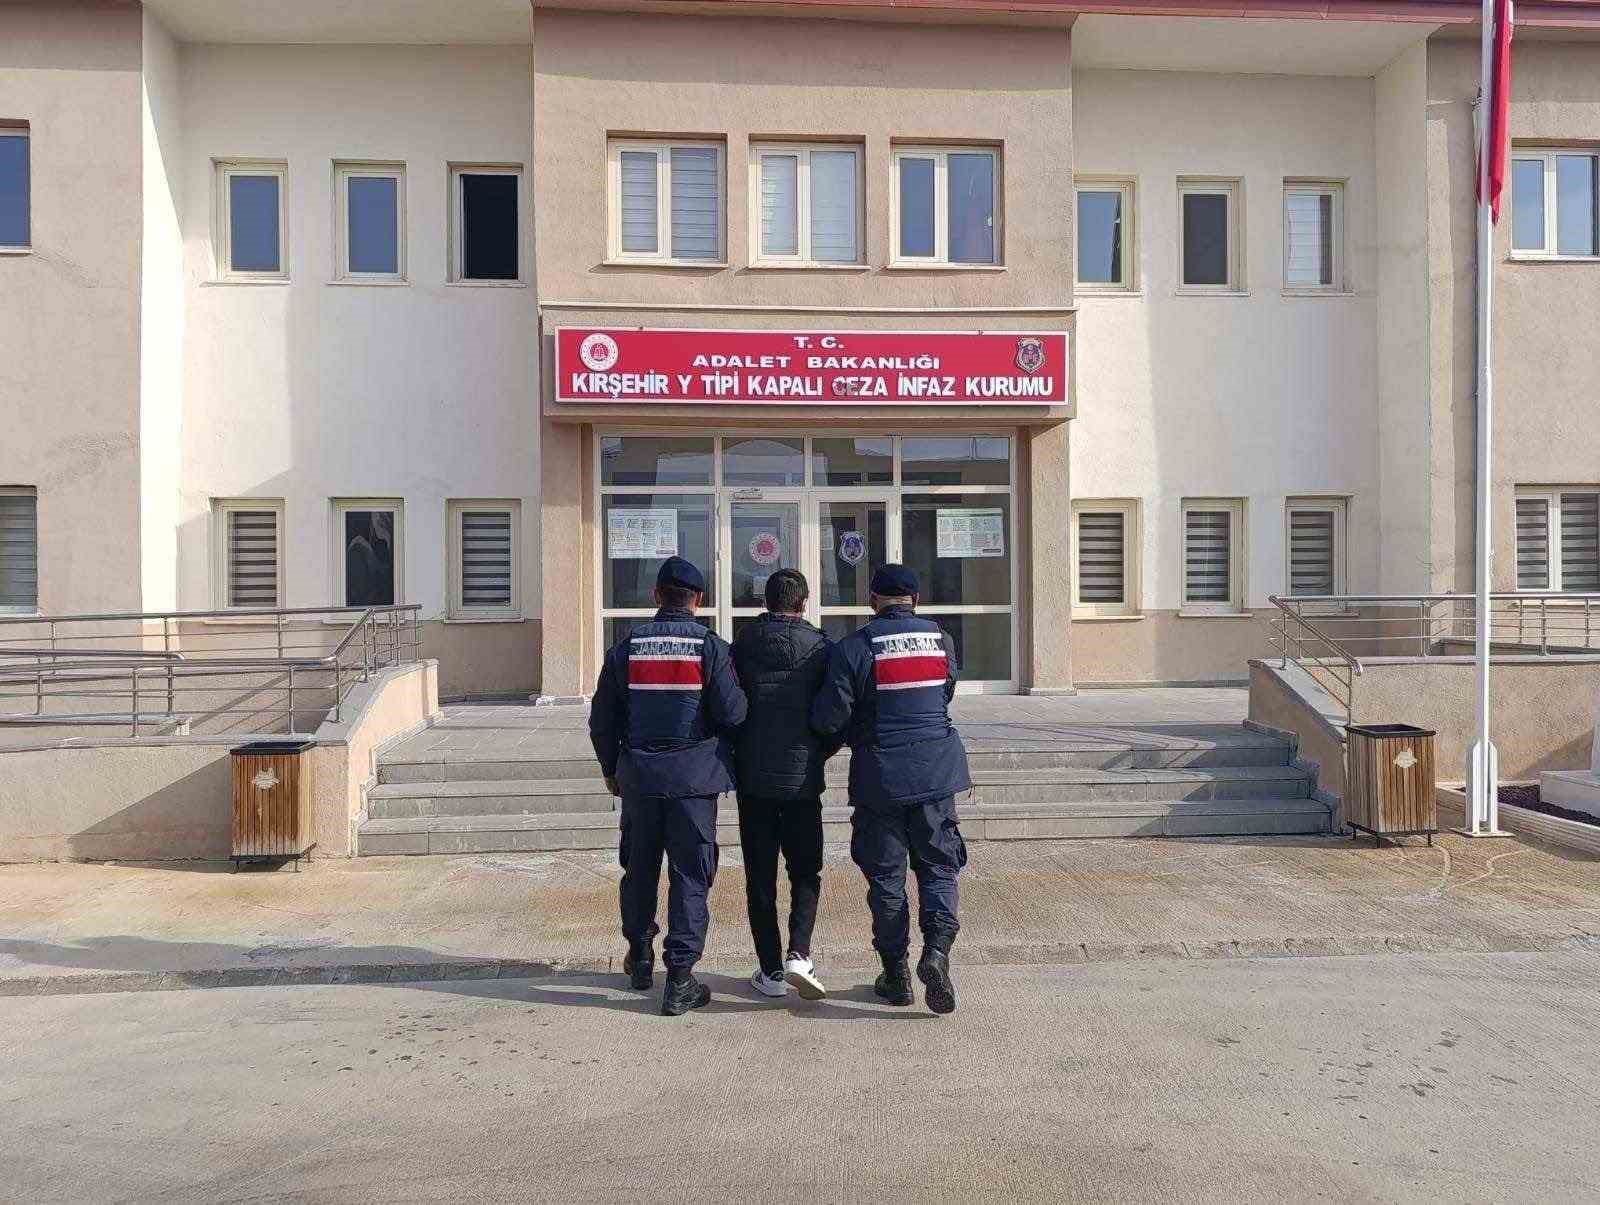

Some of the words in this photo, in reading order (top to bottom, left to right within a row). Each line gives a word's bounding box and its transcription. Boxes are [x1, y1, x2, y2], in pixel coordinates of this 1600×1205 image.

[794, 336, 813, 349] T.
[821, 336, 844, 349] C.
[692, 354, 791, 368] ADALET
[807, 354, 940, 369] BAKANLIĞI
[572, 369, 669, 398] KIRŞEHİR
[676, 375, 692, 395] Y
[701, 370, 739, 396] TİPİ
[748, 375, 823, 396] KAPALI
[831, 376, 888, 397] CEZA
[898, 372, 956, 396] İNFAZ
[965, 376, 1053, 397] KURUMU
[635, 641, 697, 655] JANDARMA
